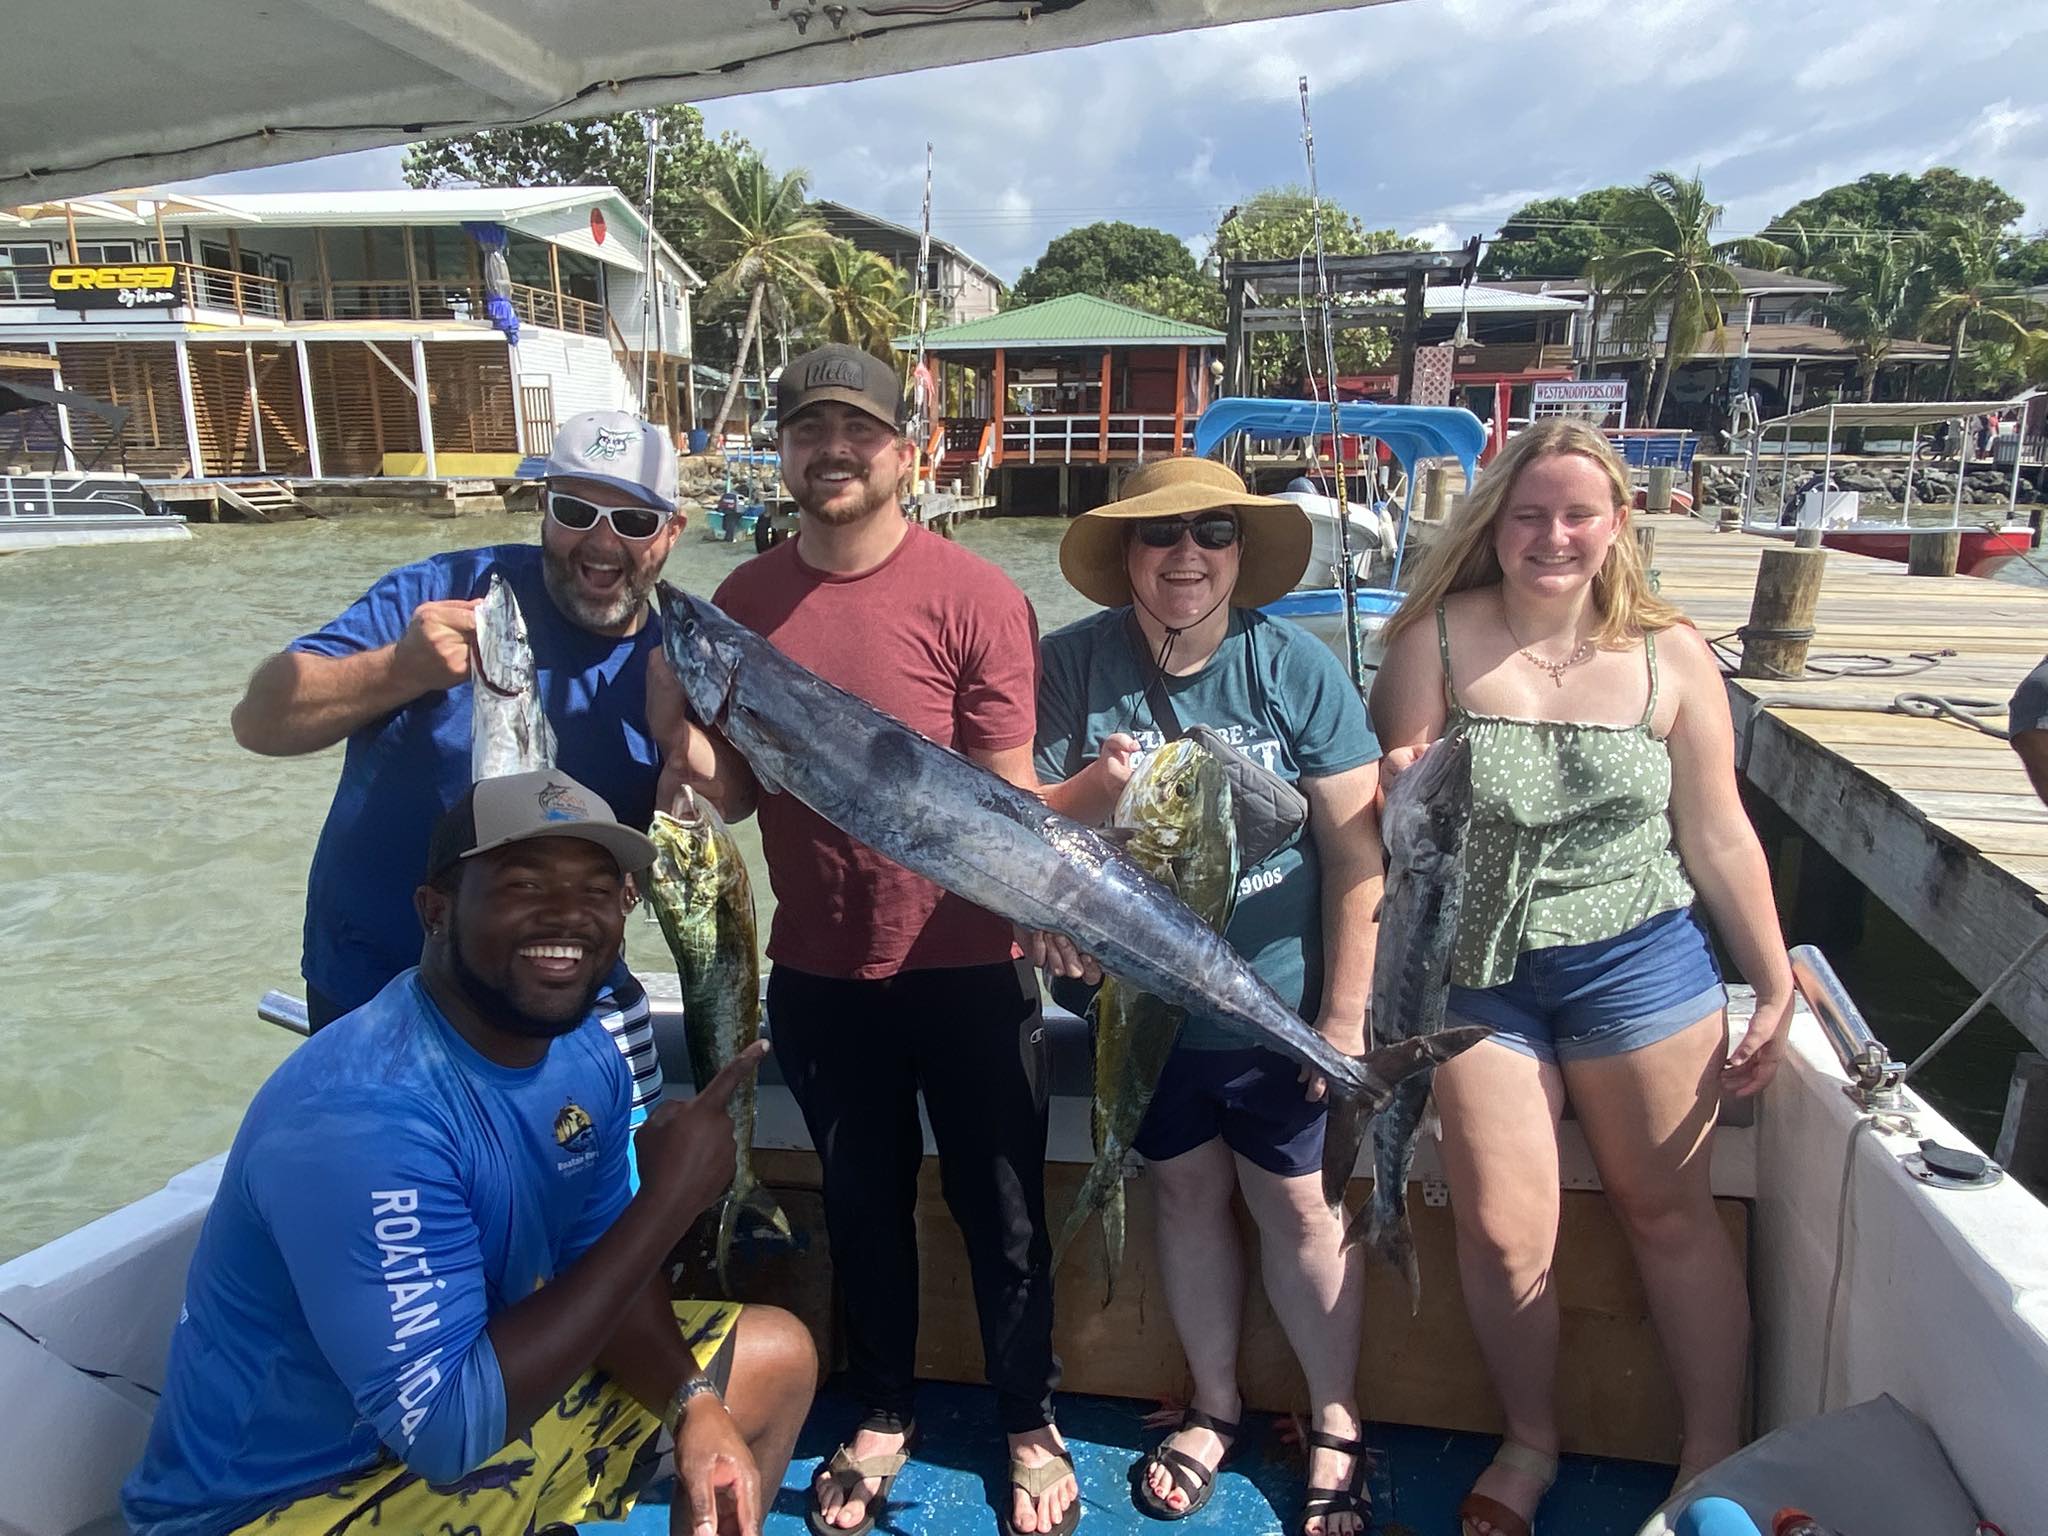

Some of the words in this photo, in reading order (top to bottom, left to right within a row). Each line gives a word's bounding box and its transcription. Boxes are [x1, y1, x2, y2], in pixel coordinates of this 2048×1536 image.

[49, 266, 176, 290] CRESSI
[1536, 384, 1624, 399] WESTENDDIVERS.COM
[371, 1188, 447, 1352] ROATÁN,
